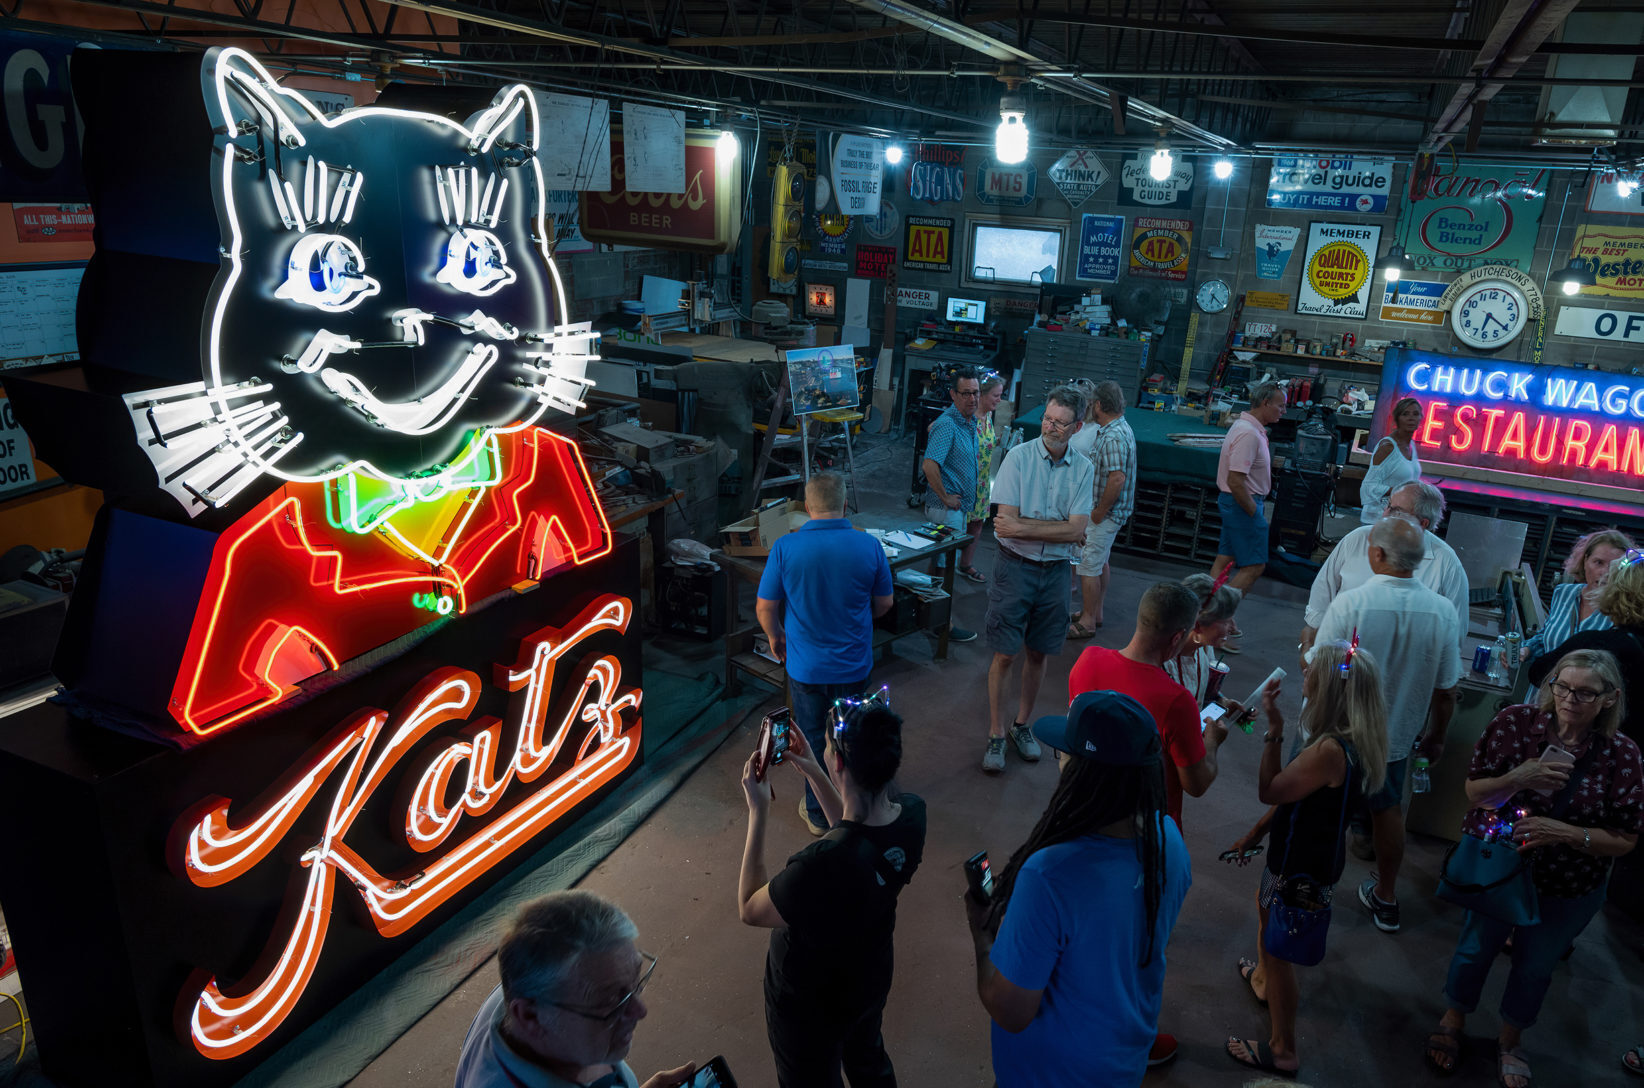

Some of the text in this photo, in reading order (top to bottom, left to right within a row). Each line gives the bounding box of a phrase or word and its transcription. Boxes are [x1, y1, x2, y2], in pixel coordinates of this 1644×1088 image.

[991, 172, 1023, 192] MTS
[1057, 169, 1101, 183] THINK!
[1331, 171, 1386, 190] guide
[841, 179, 861, 193] FOSSIL
[913, 164, 964, 201] SIGNS
[1135, 177, 1179, 189] TOURIST
[1139, 190, 1172, 201] GUIDE
[1299, 195, 1310, 204] IT
[1312, 196, 1342, 206] HERE
[24, 214, 39, 225] ALL
[630, 212, 672, 228] BEER
[909, 217, 951, 227] RECOMMENDED
[1138, 218, 1190, 230] RECOMMENDED
[1437, 217, 1490, 232] Benzol
[1090, 232, 1117, 245] MOTEL
[1147, 229, 1178, 240] MEMBER
[1320, 228, 1371, 239] MEMBER
[1438, 231, 1484, 245] Blend
[910, 229, 945, 259] ATA
[1145, 239, 1175, 259] ATA
[1083, 245, 1120, 257] BLUE BOOK
[1581, 246, 1629, 256] THE BEST
[858, 251, 894, 264] HOLIDAY
[1318, 249, 1361, 270] QUALITY
[1443, 257, 1476, 268] OUT
[859, 262, 887, 272] MOTE
[1316, 270, 1356, 282] COURTS
[1319, 280, 1350, 290] UNITED
[1408, 281, 1427, 295] Your
[1480, 293, 1487, 301] 11
[1489, 291, 1499, 300] 12
[1502, 295, 1507, 303] 1
[1298, 302, 1365, 316] Travel First Class
[1468, 300, 1479, 308] 10
[1507, 302, 1514, 311] 2
[1463, 309, 1470, 318] 9
[1508, 313, 1516, 322] 3
[1464, 319, 1471, 328] 8
[1472, 327, 1479, 336] 7
[1481, 331, 1488, 339] 6
[1492, 329, 1499, 338] 5
[1407, 362, 1533, 400] CHUCK
[1416, 400, 1644, 476] ESTAURAN
[184, 594, 643, 1060] Katz
